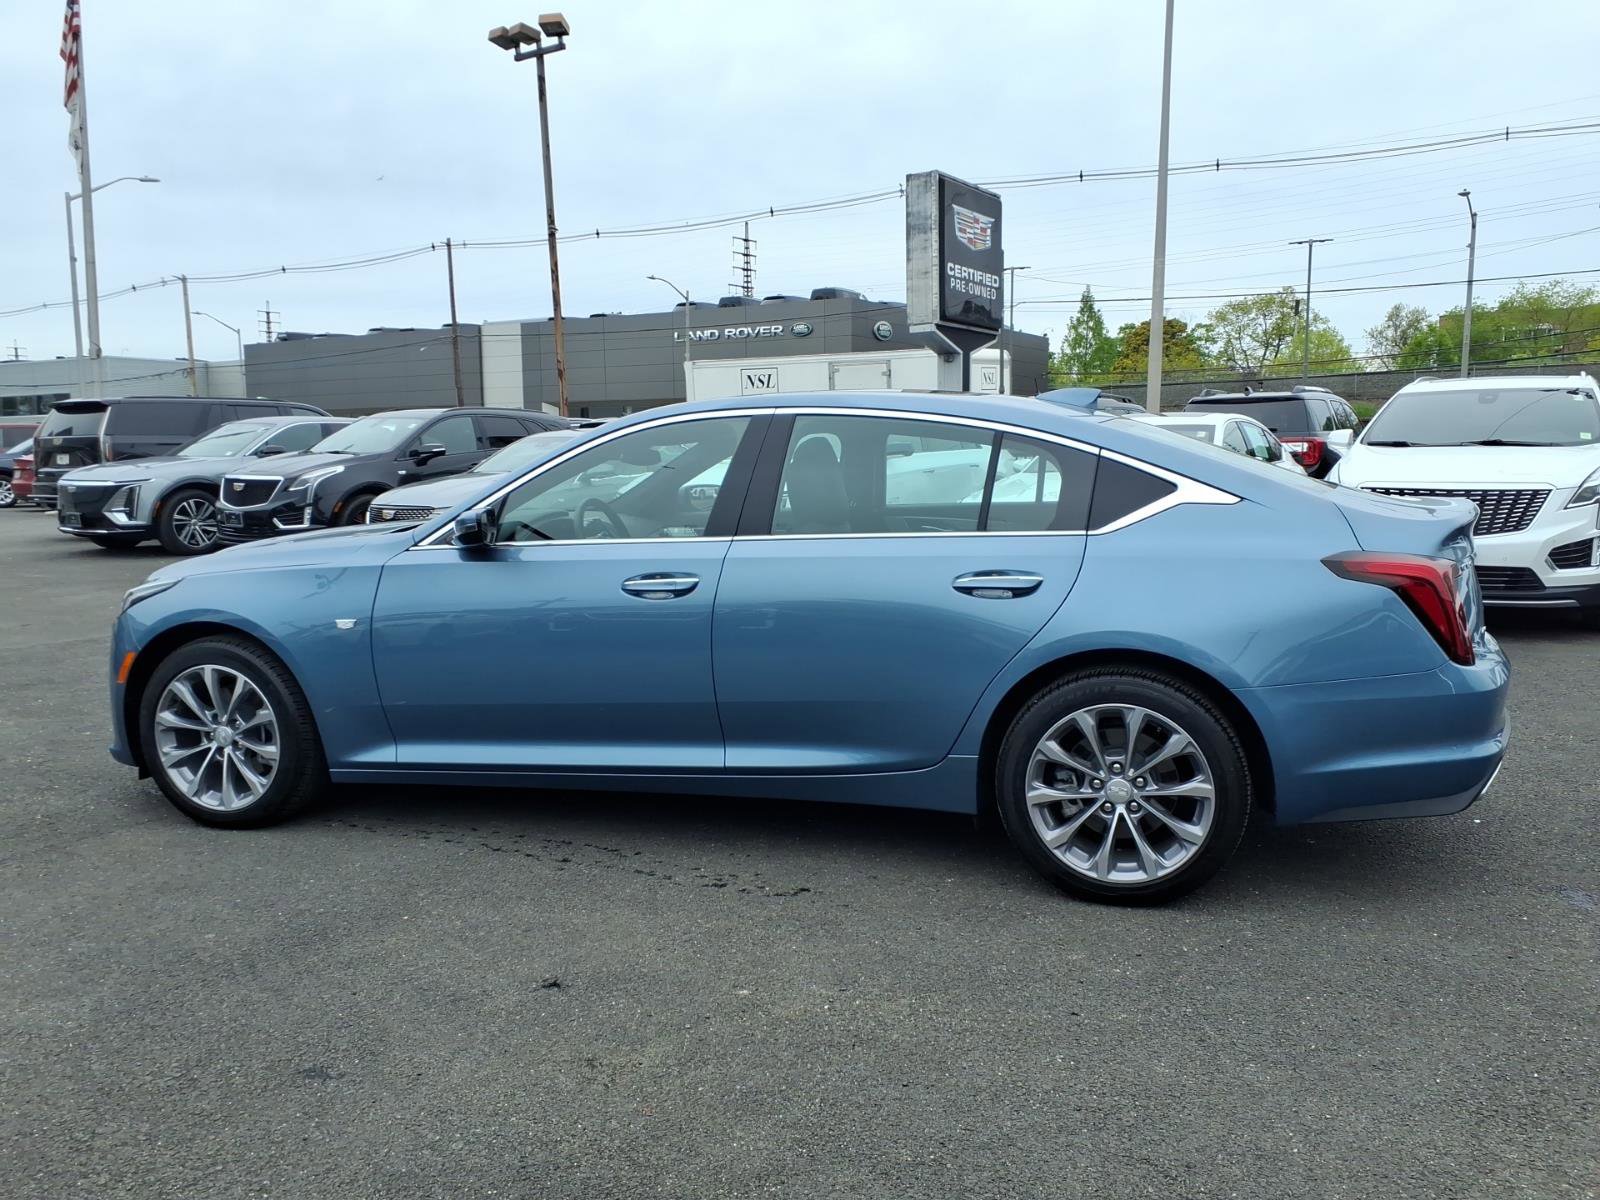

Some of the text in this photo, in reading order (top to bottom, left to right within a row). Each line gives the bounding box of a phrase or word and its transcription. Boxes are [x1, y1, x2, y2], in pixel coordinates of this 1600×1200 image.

[947, 262, 999, 288] CERTIFIED
[950, 277, 997, 300] PRE-OWNED
[674, 329, 719, 342] LAND
[724, 325, 784, 339] ROVER
[744, 373, 776, 389] NSL
